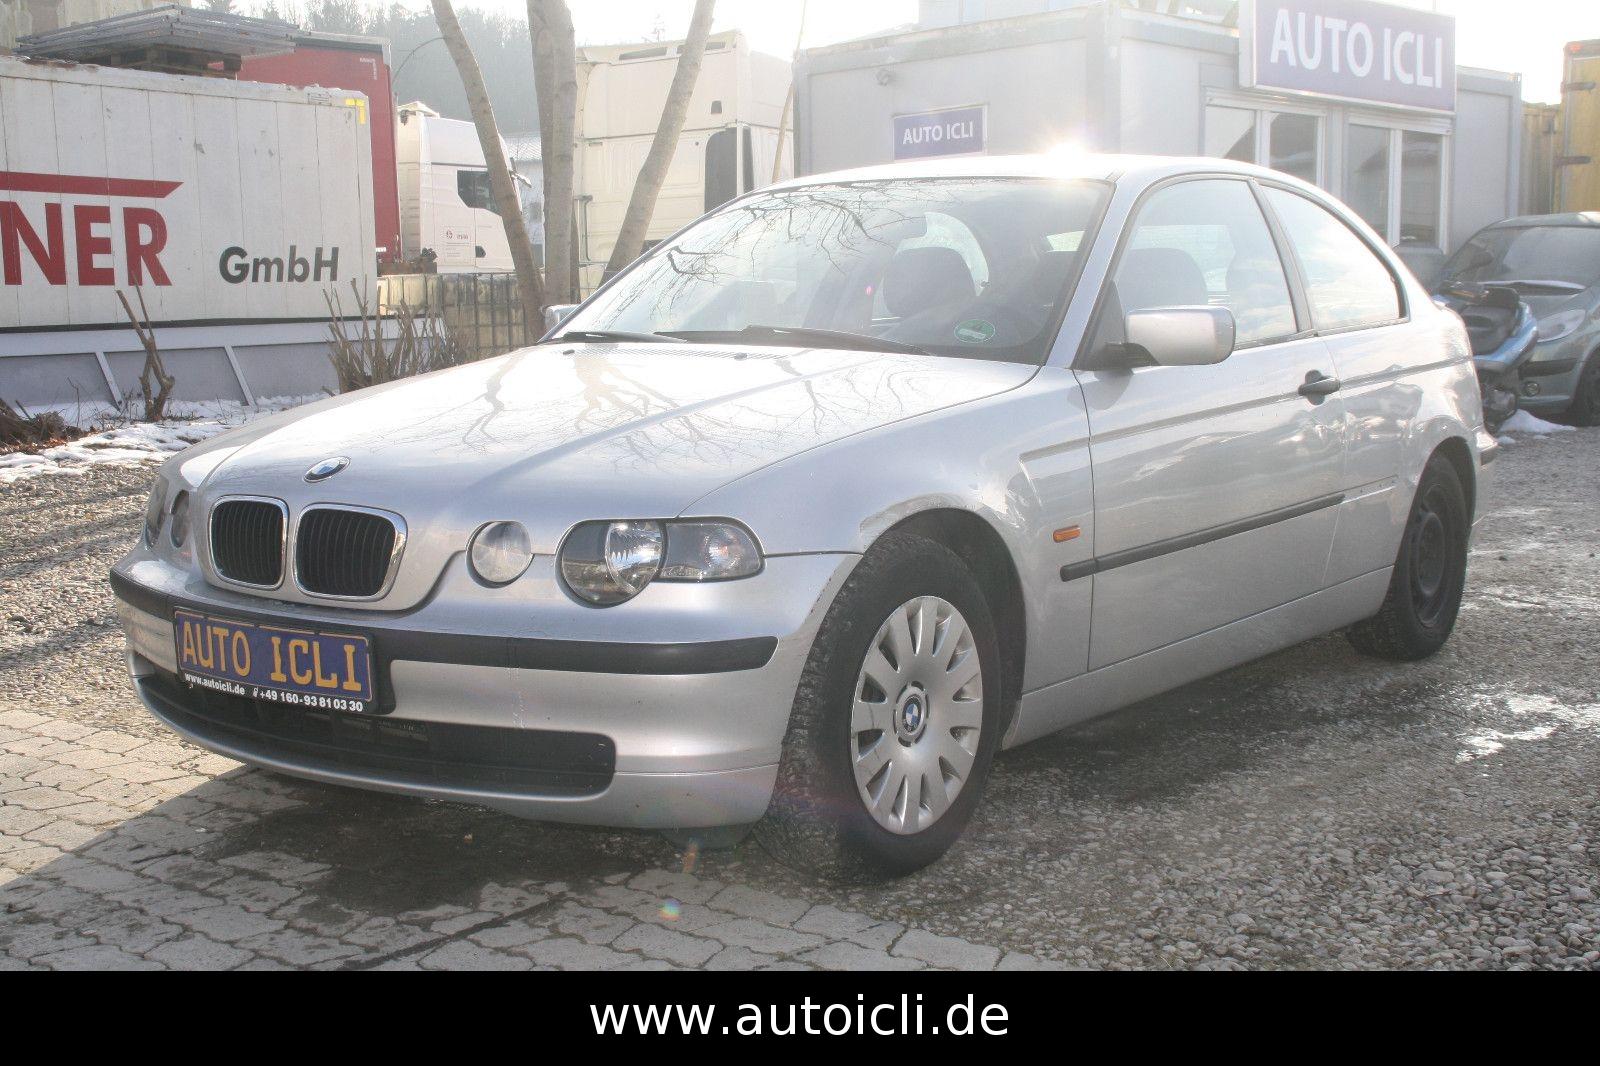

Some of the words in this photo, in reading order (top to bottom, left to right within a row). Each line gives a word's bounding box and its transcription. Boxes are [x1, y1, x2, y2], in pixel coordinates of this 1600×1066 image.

[1270, 8, 1374, 78] AUTO
[1383, 27, 1443, 89] ICLI
[902, 125, 943, 145] AUTO
[946, 121, 974, 140] ICLI
[0, 201, 173, 286] NER
[219, 245, 340, 285] GmbH
[182, 621, 251, 677] AUTO
[270, 636, 362, 692] ICLI
[184, 672, 246, 696] www.autoicli.de
[260, 689, 278, 701] +49
